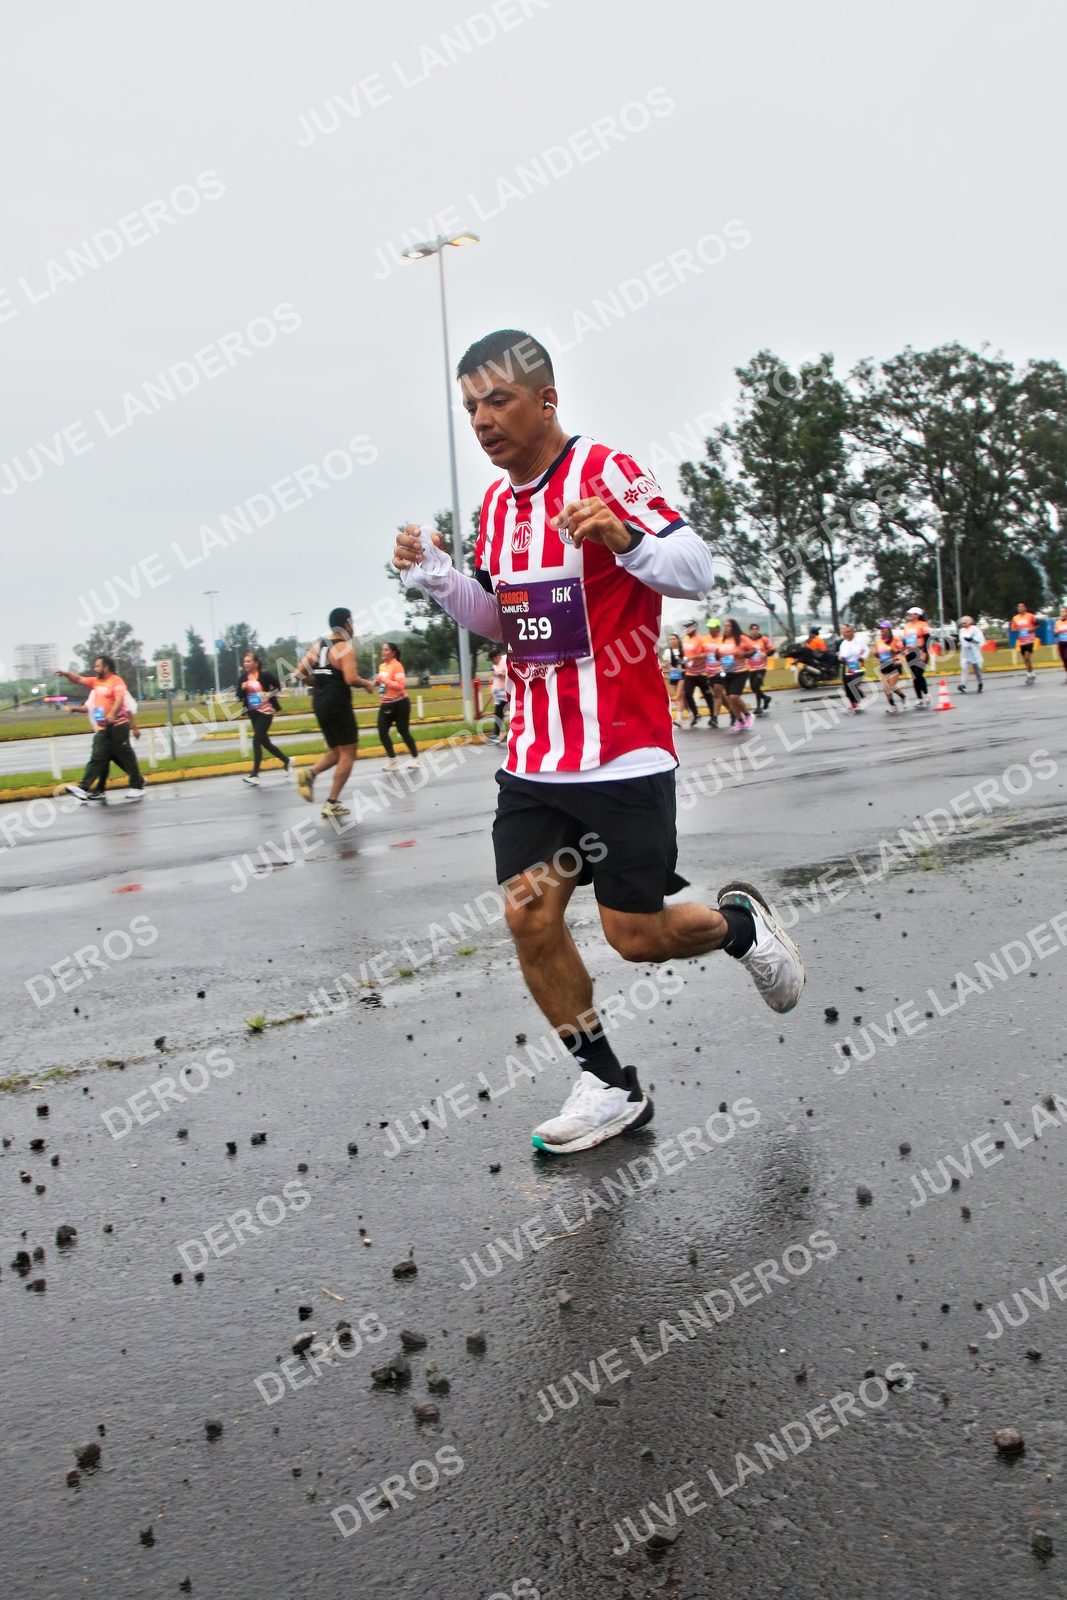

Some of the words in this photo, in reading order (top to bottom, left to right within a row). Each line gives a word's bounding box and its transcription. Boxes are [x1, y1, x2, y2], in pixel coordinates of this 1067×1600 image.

[512, 524, 531, 550] MG
[500, 590, 529, 605] CARRERA
[551, 586, 572, 604] 15K
[516, 616, 552, 640] 259
